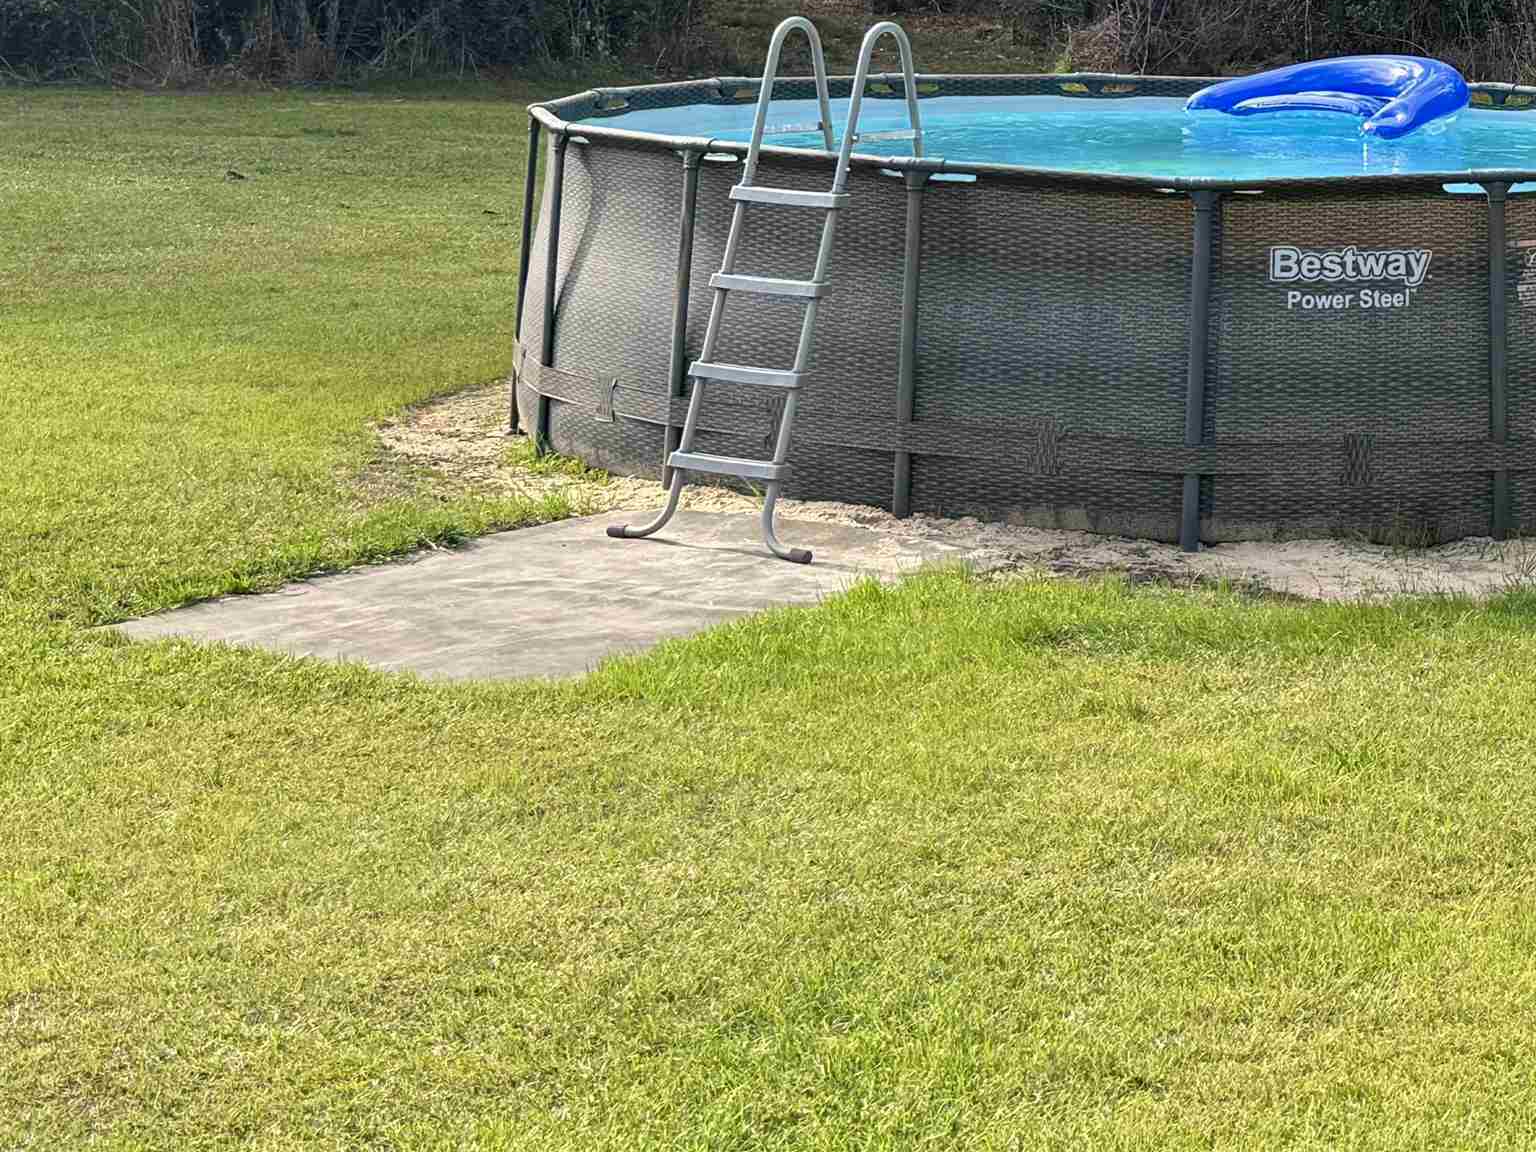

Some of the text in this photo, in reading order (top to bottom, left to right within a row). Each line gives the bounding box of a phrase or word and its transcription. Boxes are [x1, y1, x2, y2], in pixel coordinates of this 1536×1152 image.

[1270, 246, 1432, 286] Bestway
[1287, 289, 1410, 309] Power Steel
